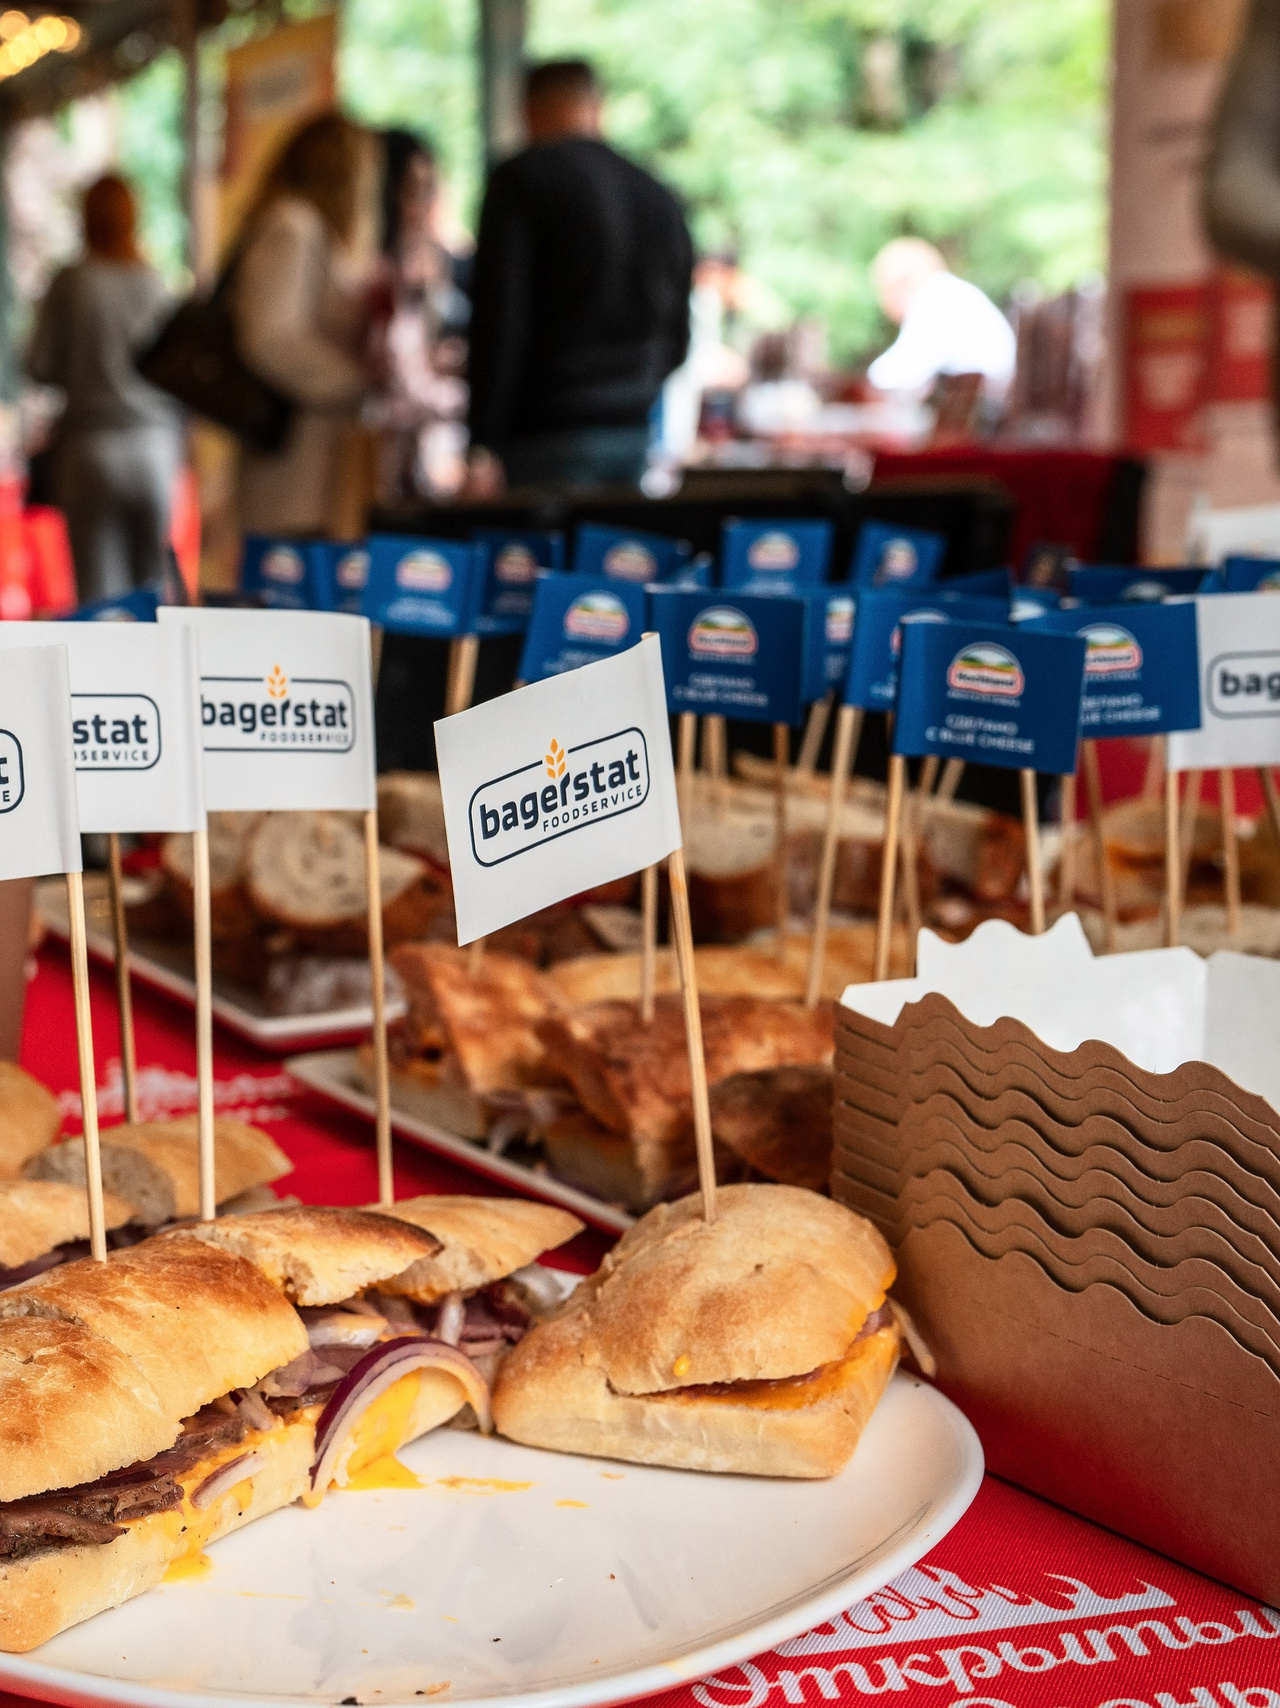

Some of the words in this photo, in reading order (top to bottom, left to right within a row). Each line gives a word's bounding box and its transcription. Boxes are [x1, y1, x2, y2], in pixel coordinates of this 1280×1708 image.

[201, 694, 348, 733] bagerstat
[479, 749, 640, 840] bagerstat
[543, 784, 642, 832] FOODSERVICE
